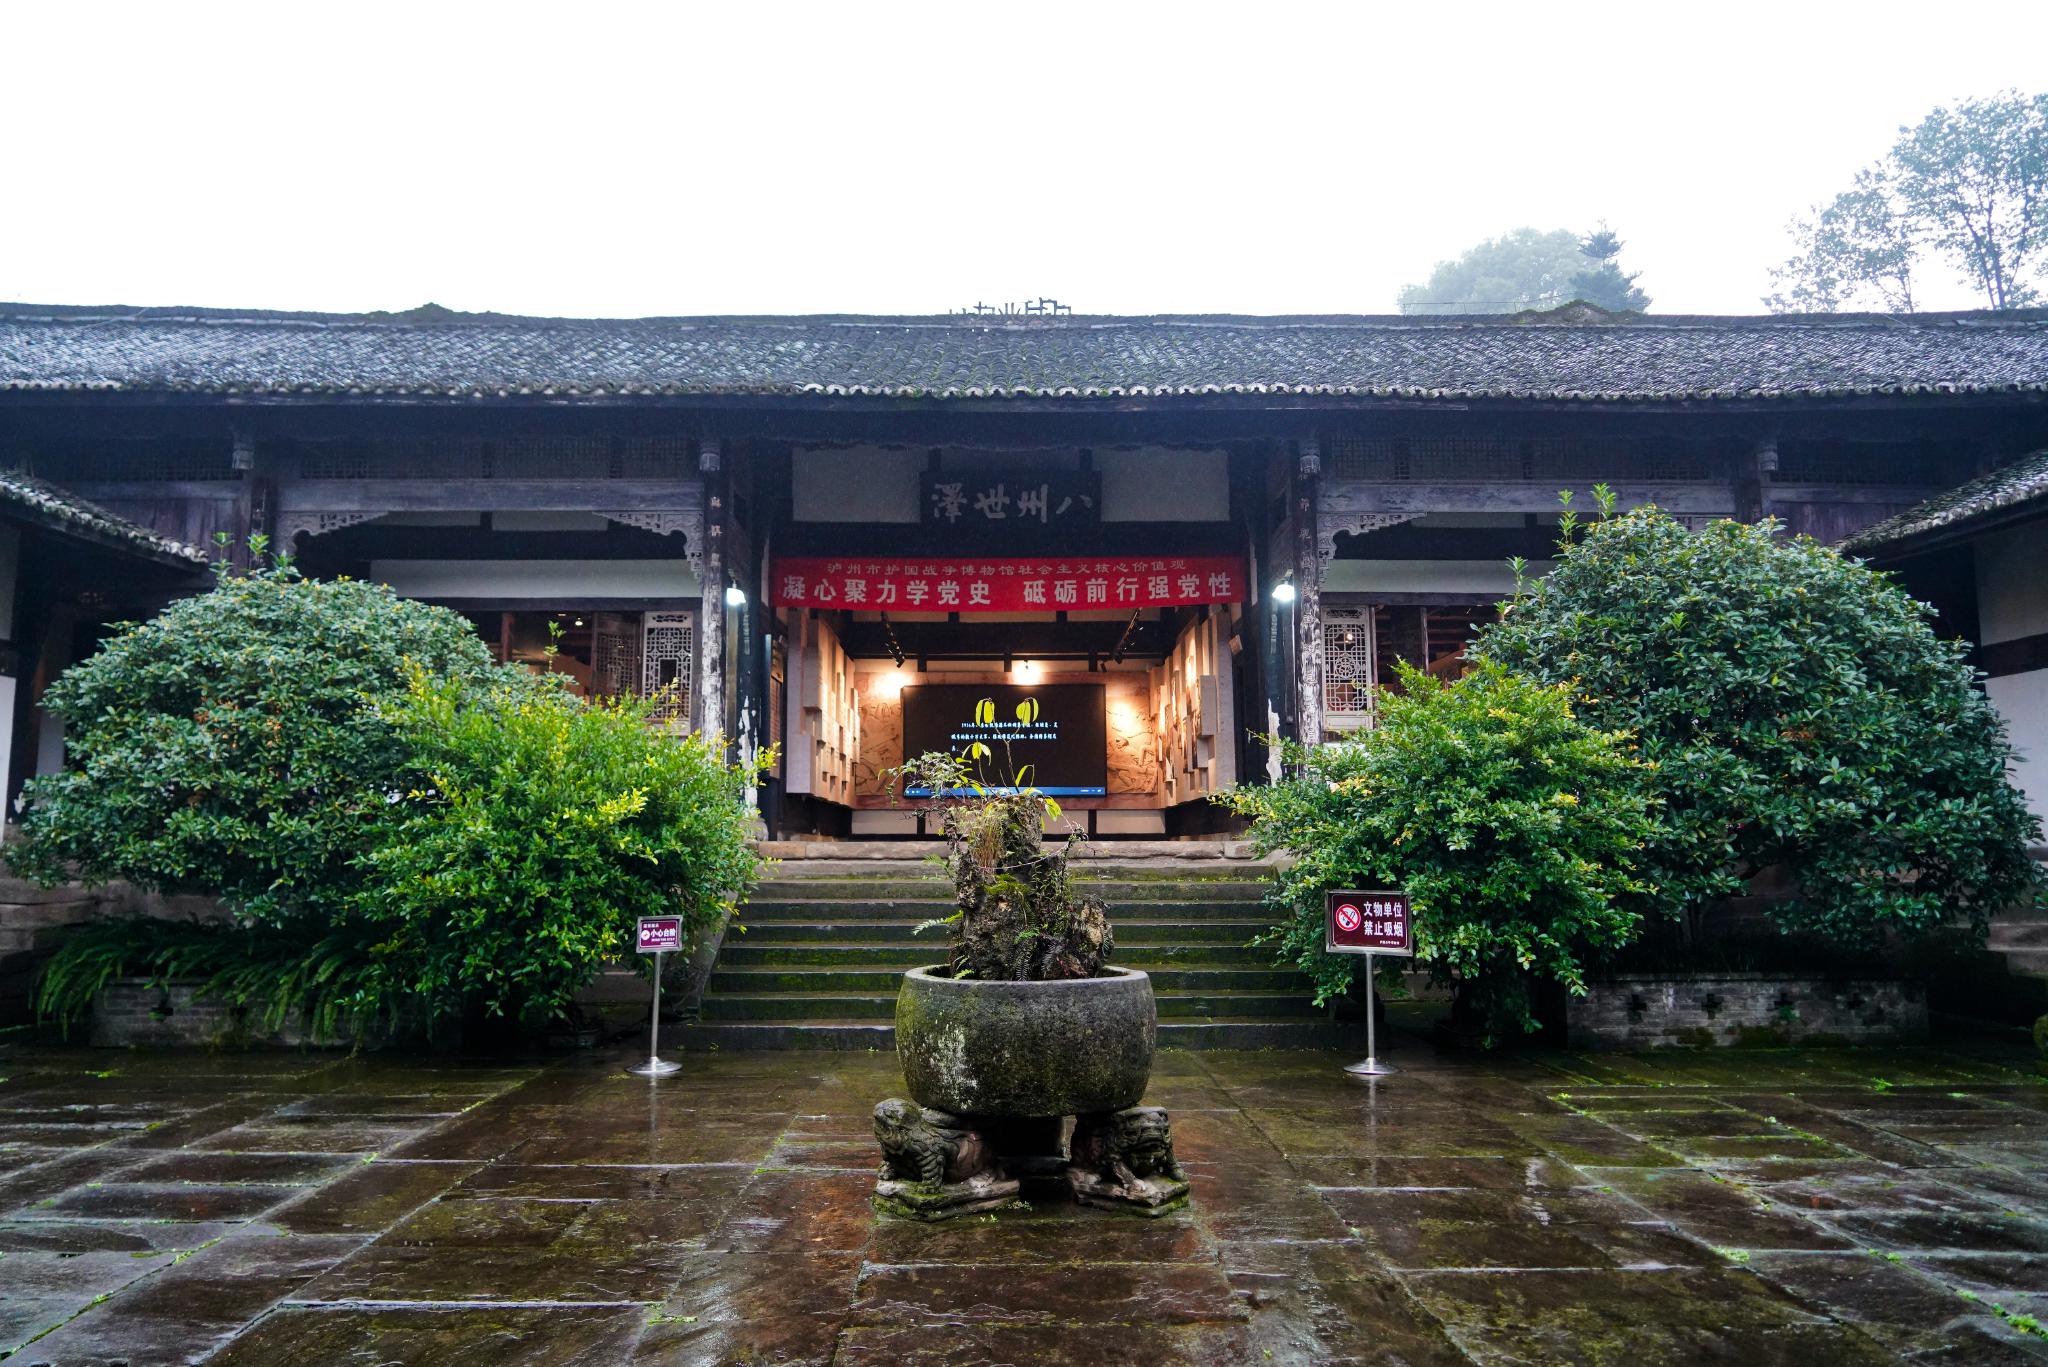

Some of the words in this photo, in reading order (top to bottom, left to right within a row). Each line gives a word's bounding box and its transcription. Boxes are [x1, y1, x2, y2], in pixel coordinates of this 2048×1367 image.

[826, 560, 1187, 577] 泸州市护国战争博物馆社会主义核心价值观
[782, 575, 991, 606] 凝心聚力学党史
[1023, 571, 1233, 605] 砥砺前行强党性
[1363, 901, 1403, 918] 文物单位
[1363, 920, 1404, 937] 禁止吸烟
